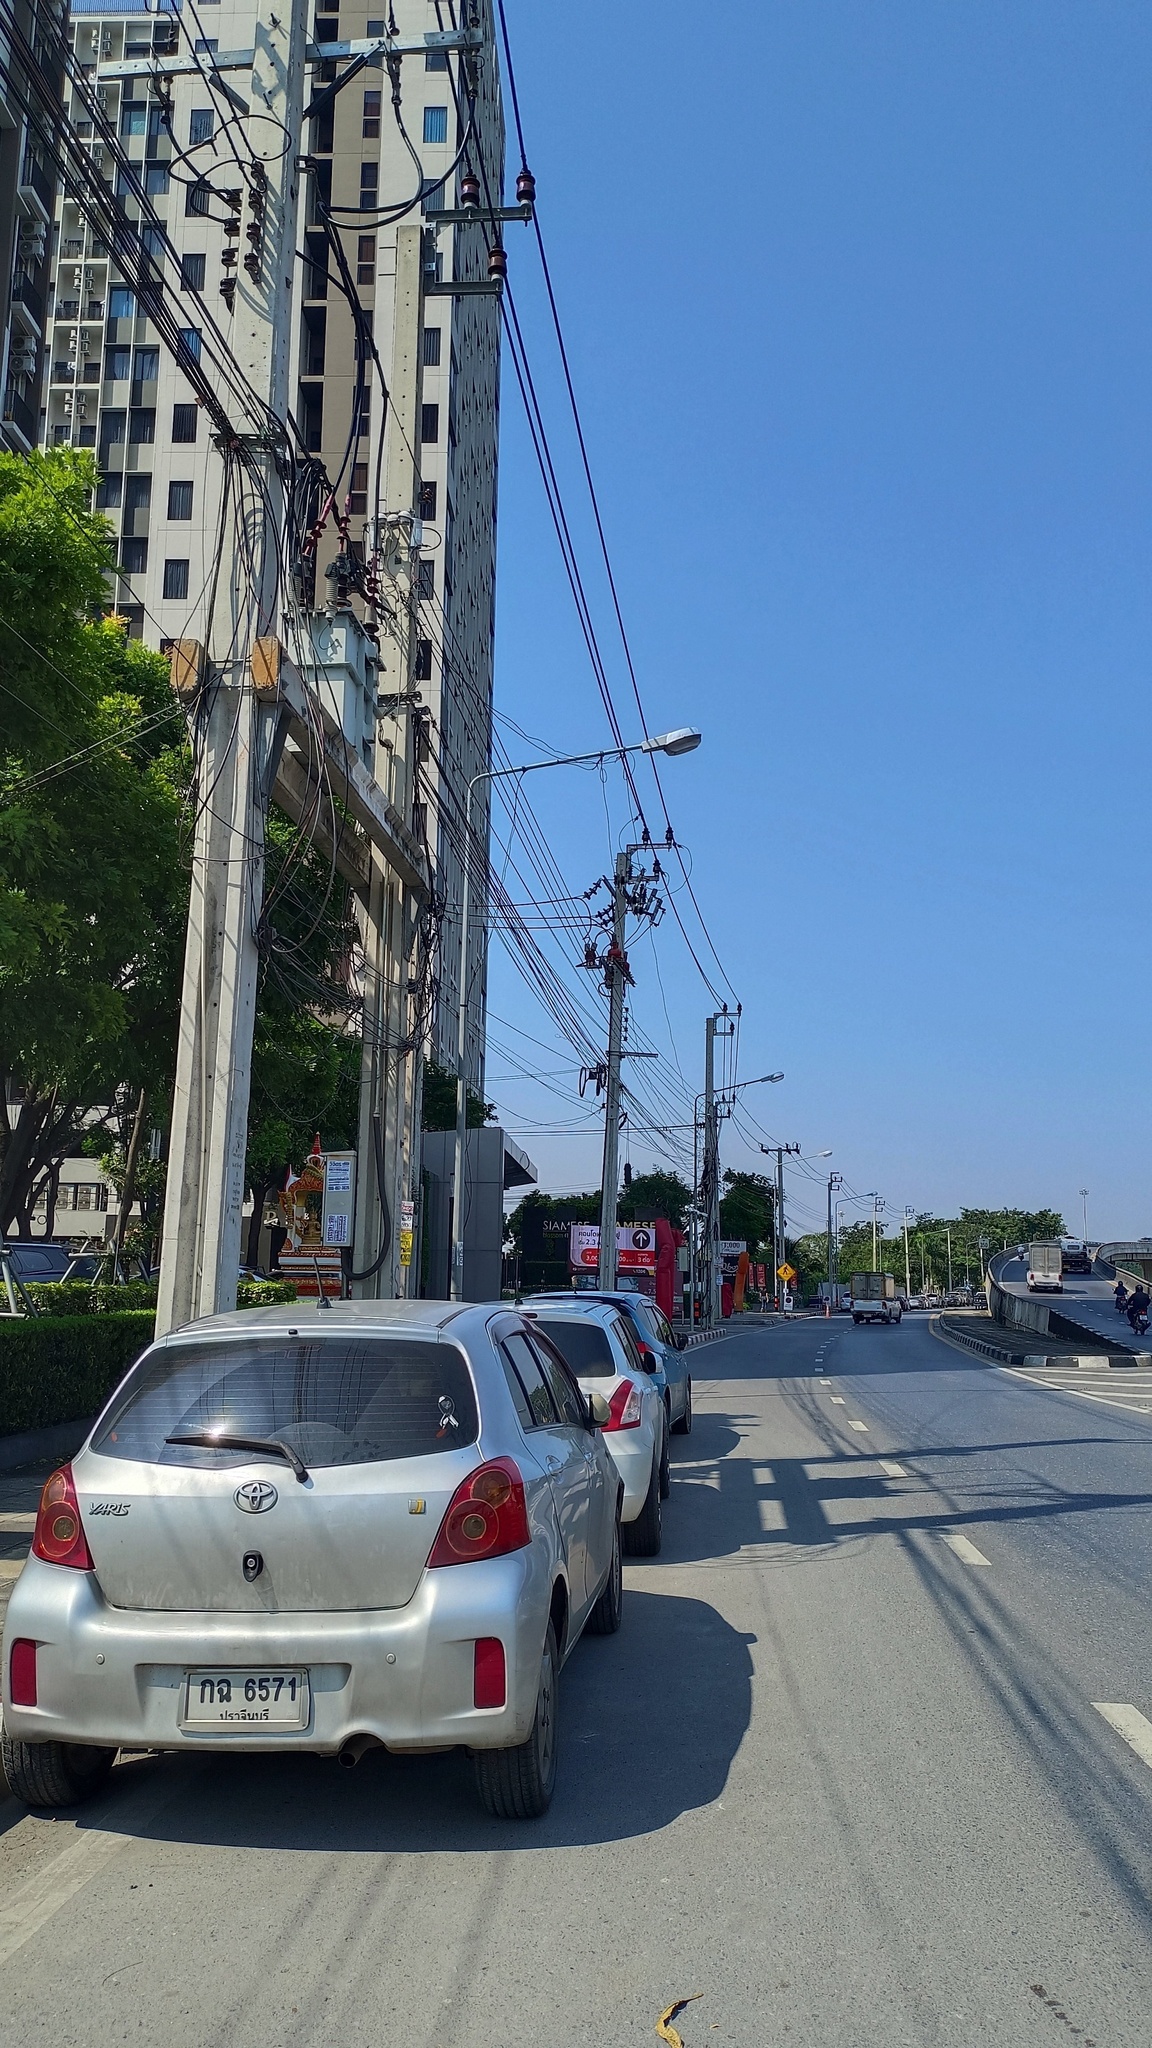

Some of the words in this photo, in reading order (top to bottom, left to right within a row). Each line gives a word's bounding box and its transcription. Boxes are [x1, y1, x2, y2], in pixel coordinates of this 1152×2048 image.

[89, 1502, 131, 1517] YARIS
[200, 1678, 232, 1703] กฉ
[244, 1677, 297, 1701] 6571
